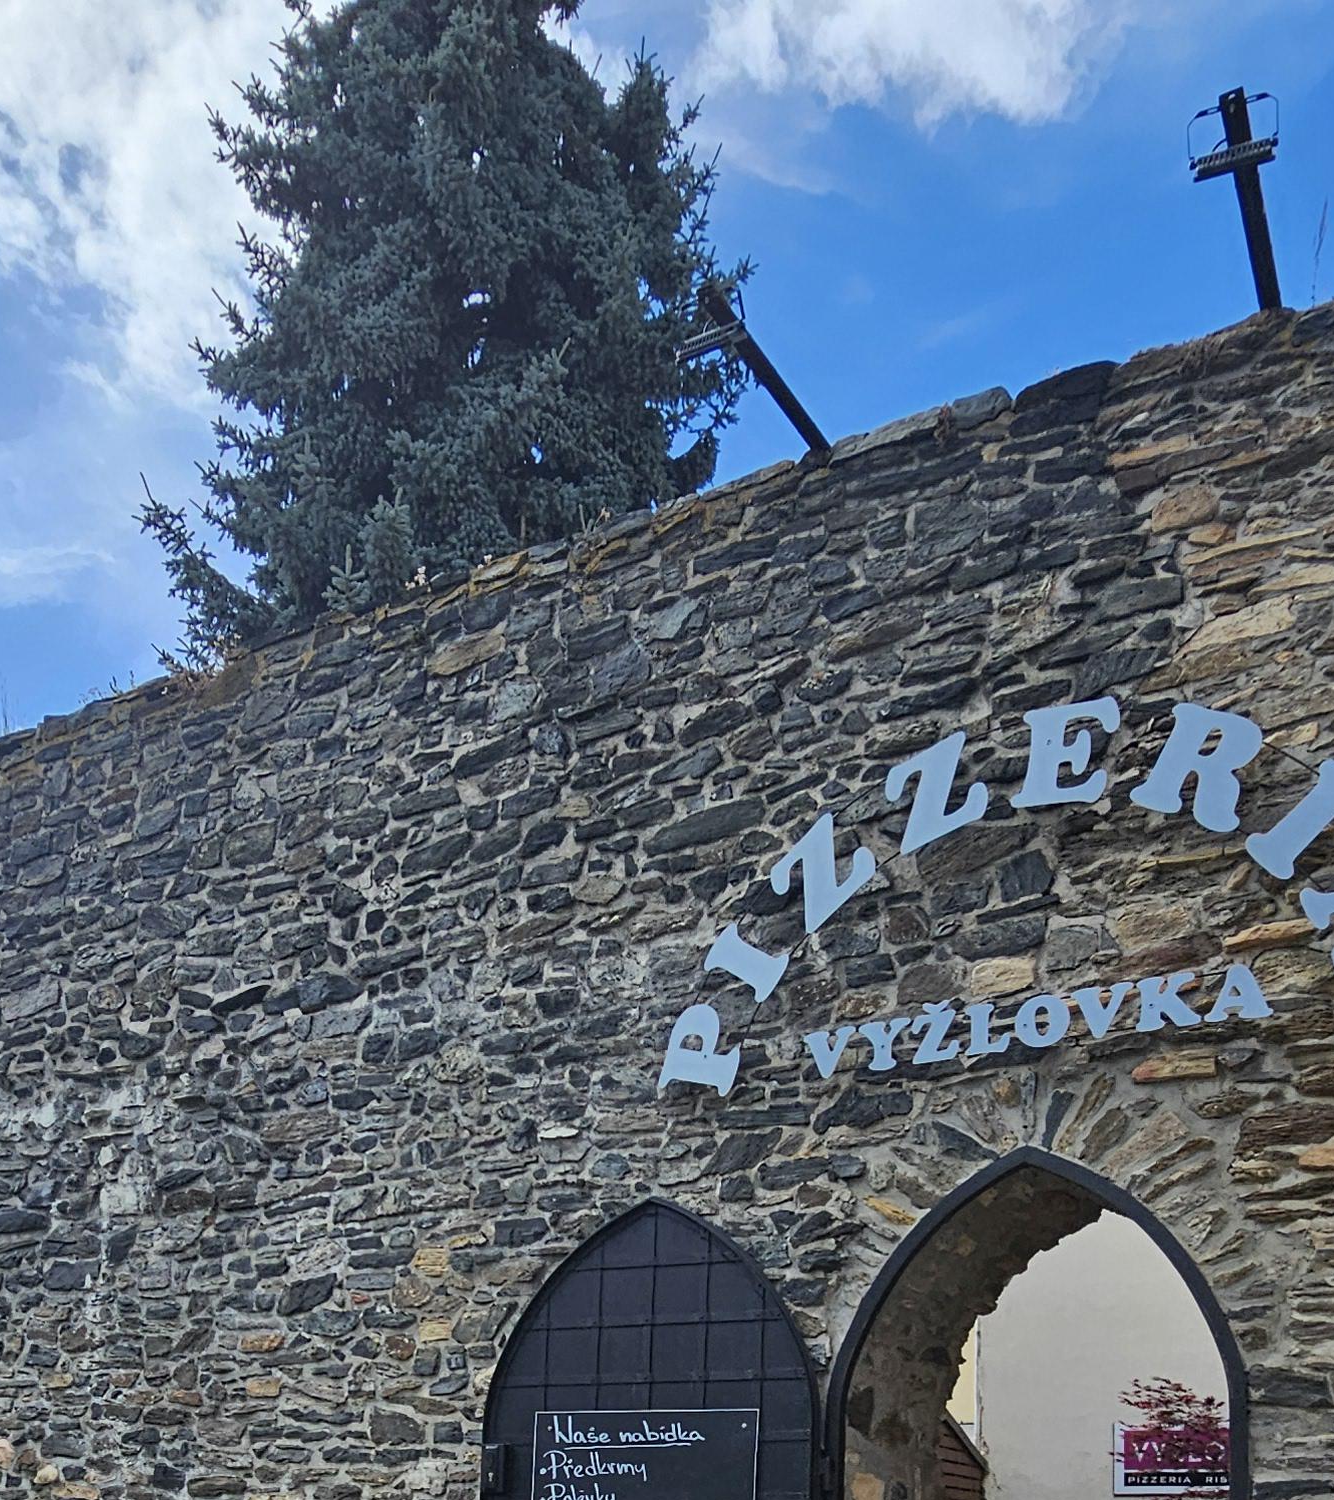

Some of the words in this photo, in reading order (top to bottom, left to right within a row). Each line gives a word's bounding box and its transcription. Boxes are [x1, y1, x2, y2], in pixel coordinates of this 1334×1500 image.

[804, 964, 1274, 1078] VYŽLOVKA
[552, 1414, 611, 1444] Naše
[618, 1420, 706, 1442] nabídka
[542, 1449, 647, 1482] Předkrmy
[1127, 1475, 1192, 1484] PIZZERIA
